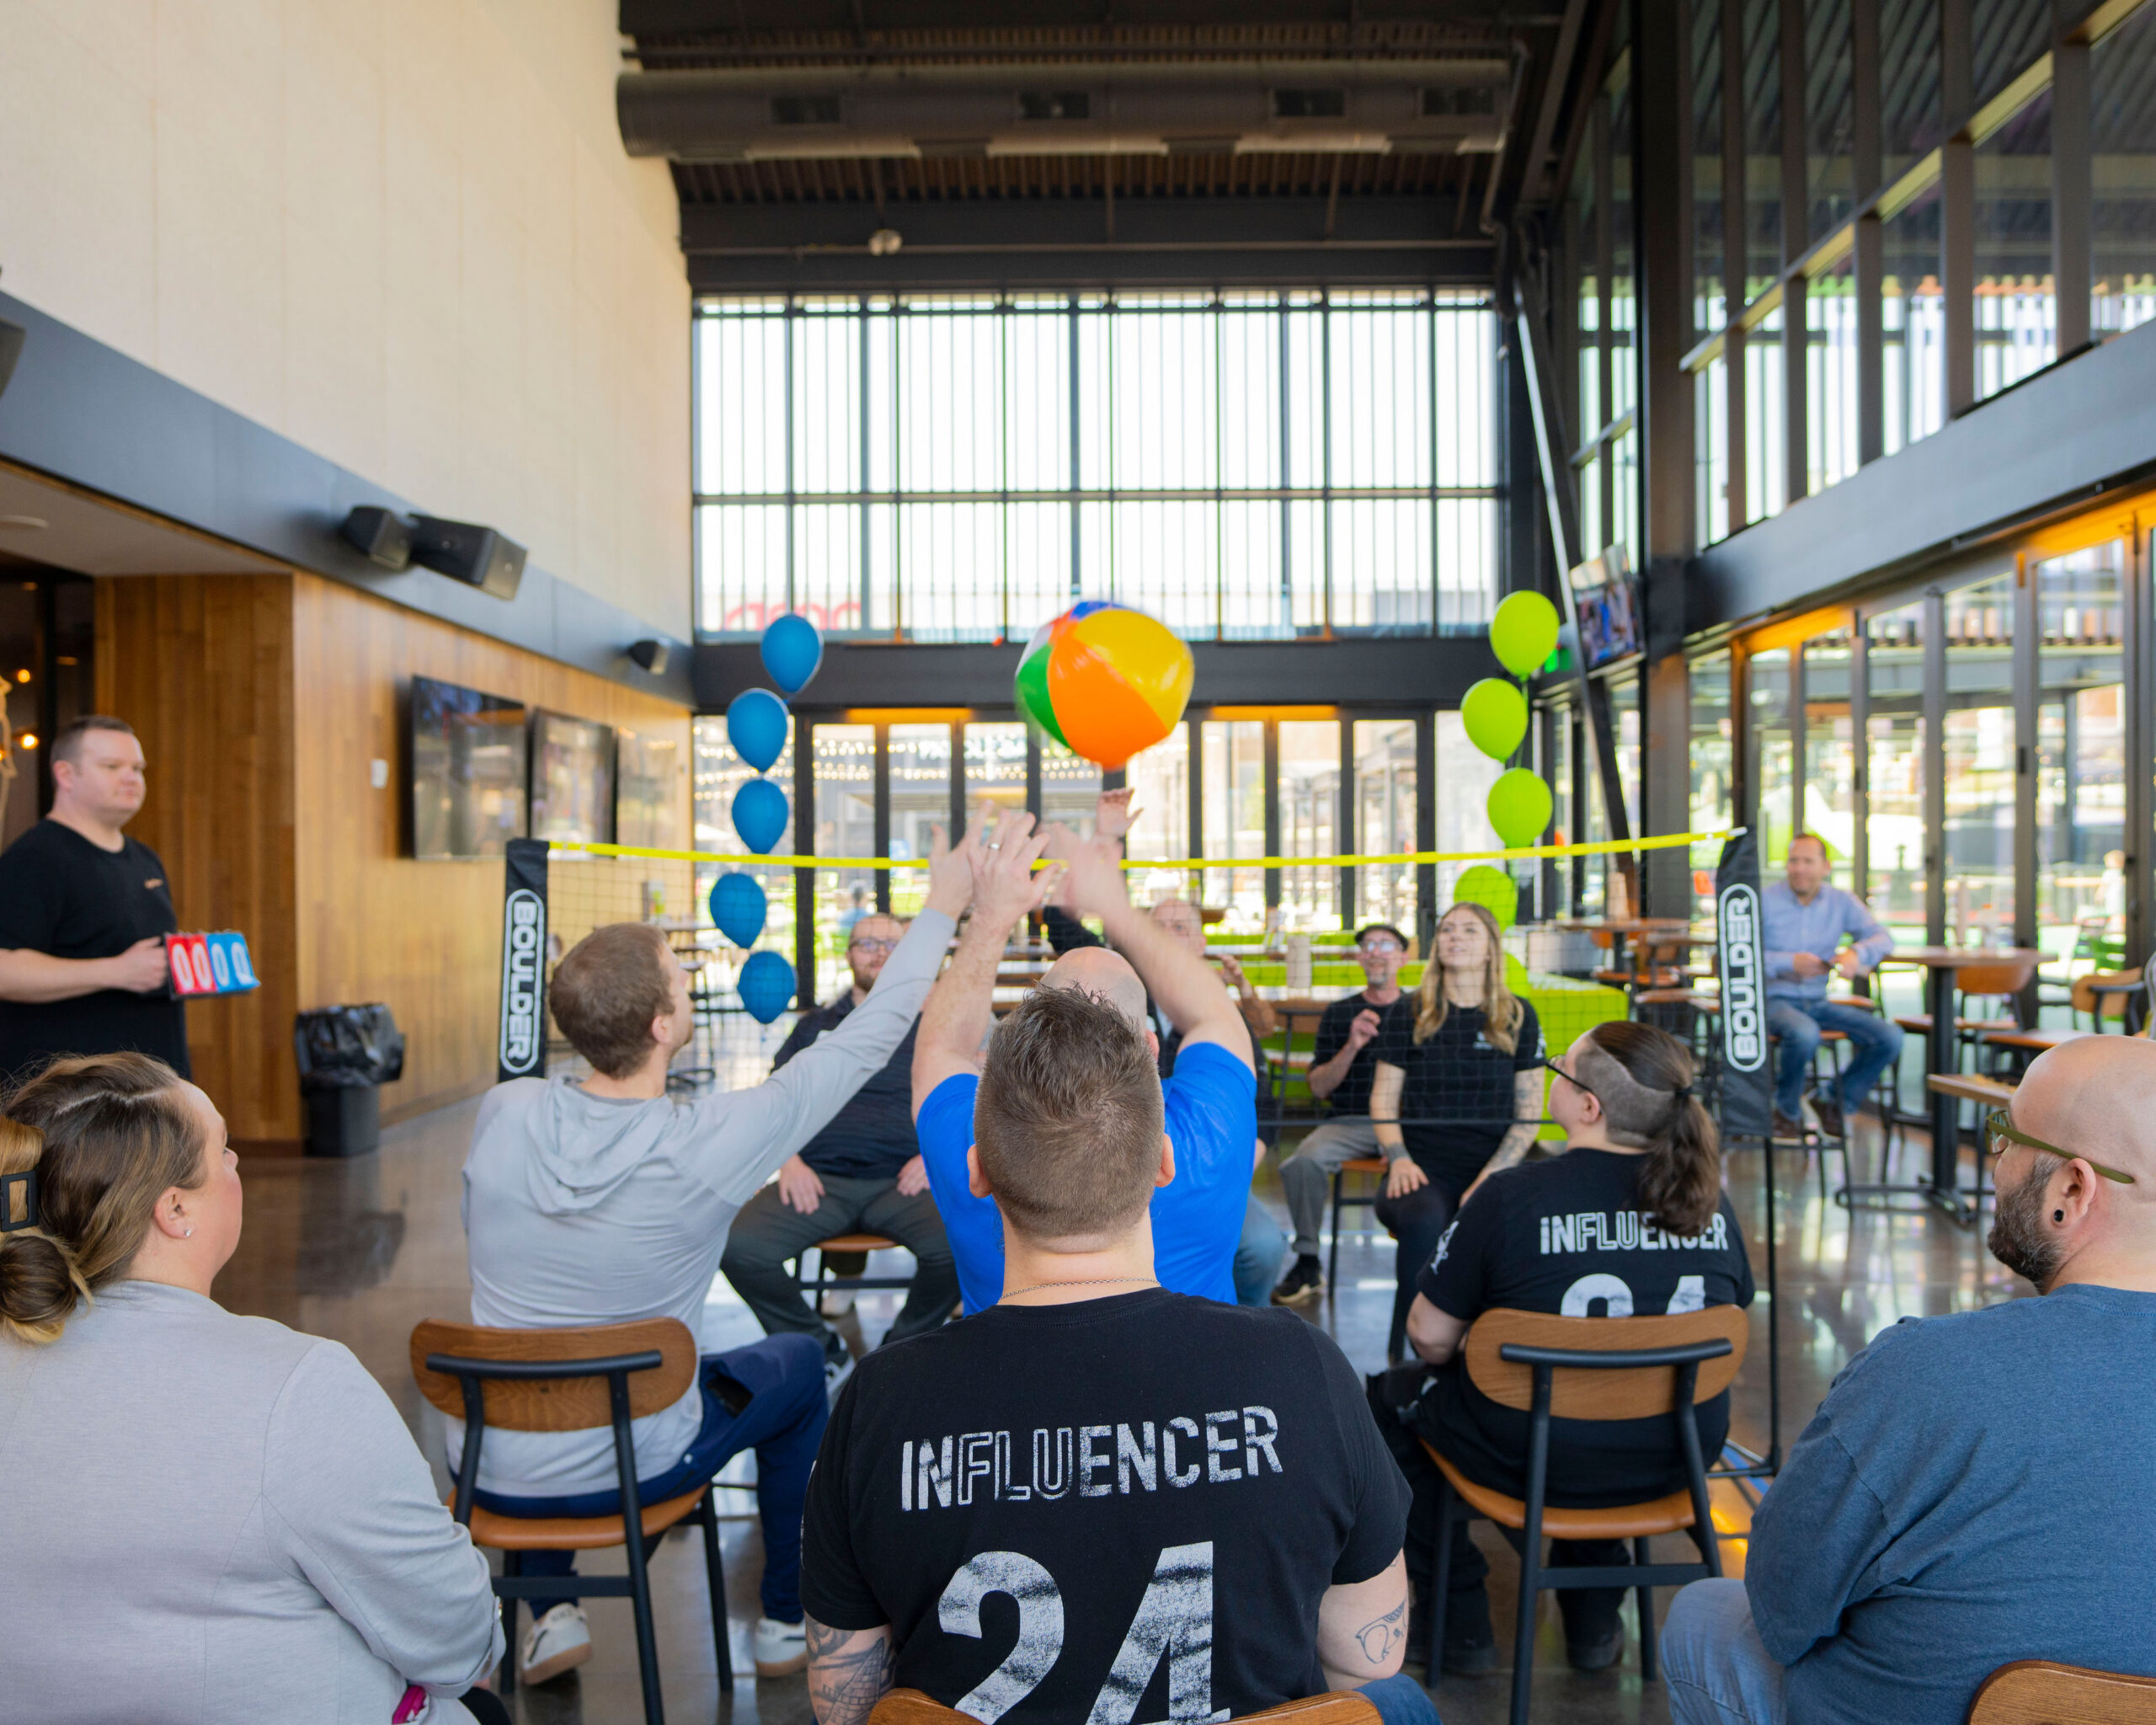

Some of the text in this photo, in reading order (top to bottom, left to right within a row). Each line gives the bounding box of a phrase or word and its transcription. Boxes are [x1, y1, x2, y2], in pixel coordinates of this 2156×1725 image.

[507, 901, 537, 1060] BOULDER
[1726, 895, 1758, 1060] BOULDER
[901, 1406, 1283, 1512] INFLUENCER
[937, 1541, 1231, 1725] 24
